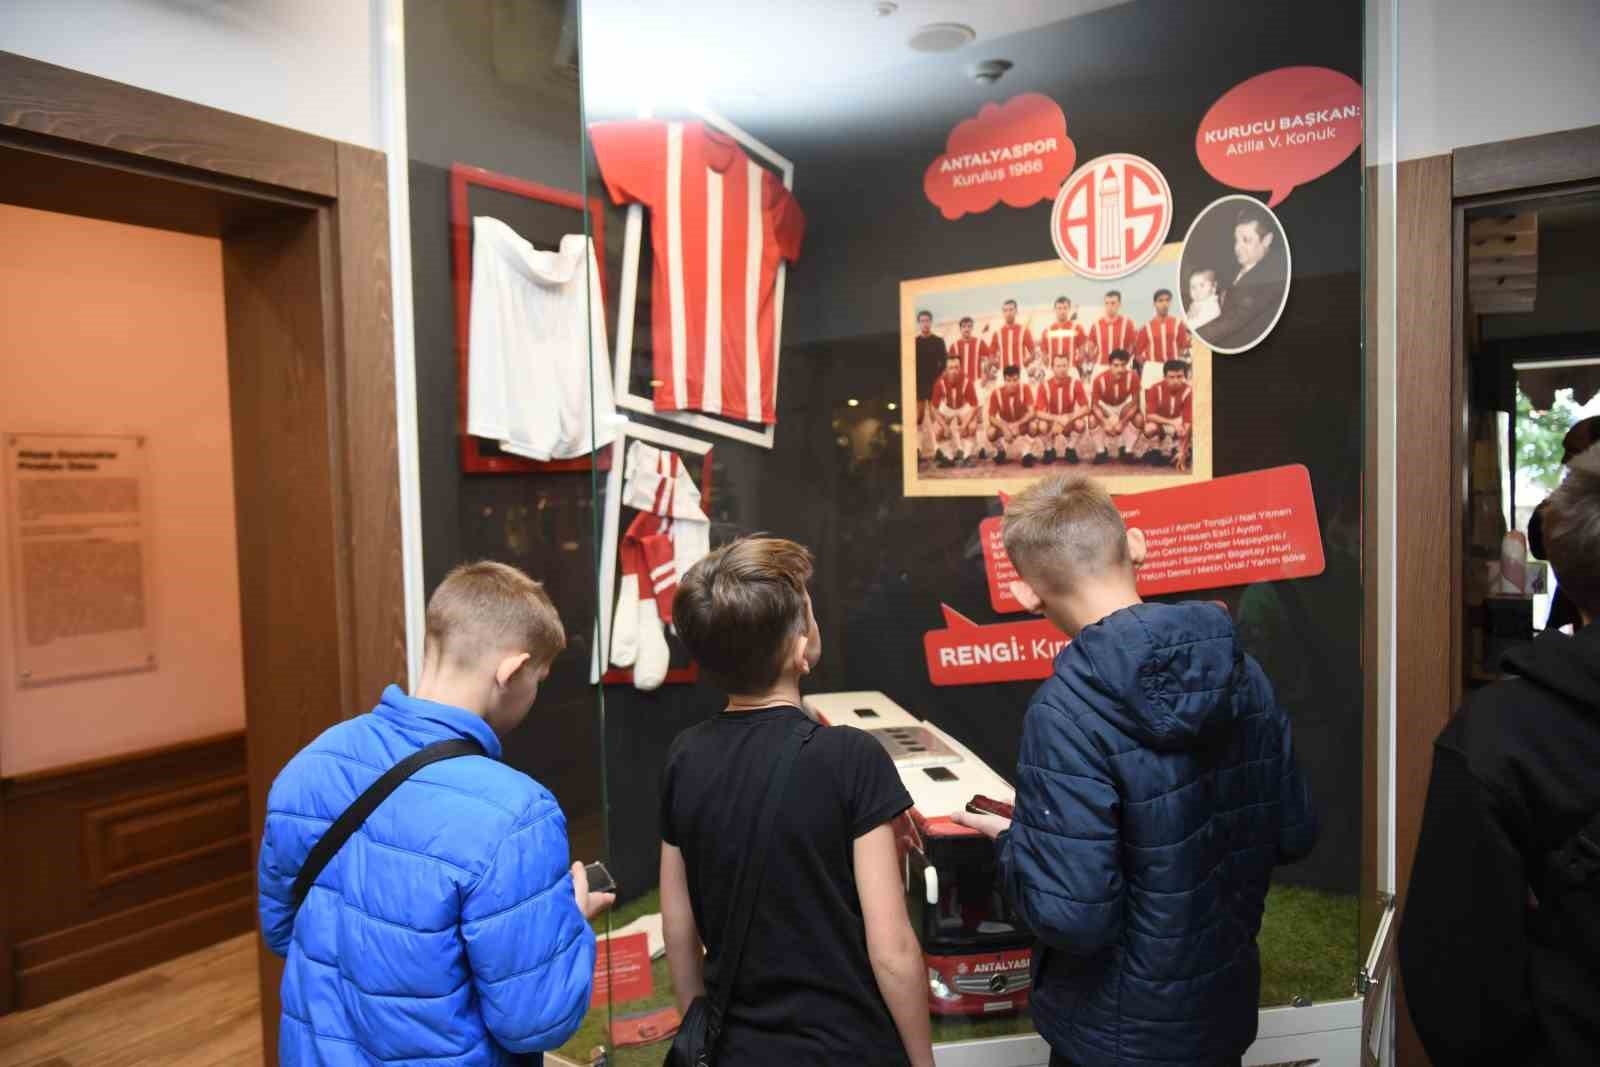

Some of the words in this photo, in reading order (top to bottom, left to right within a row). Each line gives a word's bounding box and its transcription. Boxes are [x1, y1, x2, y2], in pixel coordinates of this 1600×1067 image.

[1205, 119, 1275, 145] KURUCU
[1279, 104, 1361, 130] BAŞKAN:
[940, 137, 1058, 173] ANTALYASPOR
[1226, 138, 1265, 157] Atilla
[1268, 135, 1282, 148] V.
[1286, 126, 1337, 146] Konuk
[1008, 159, 1044, 177] 1966
[940, 636, 1026, 668] RENGİ:
